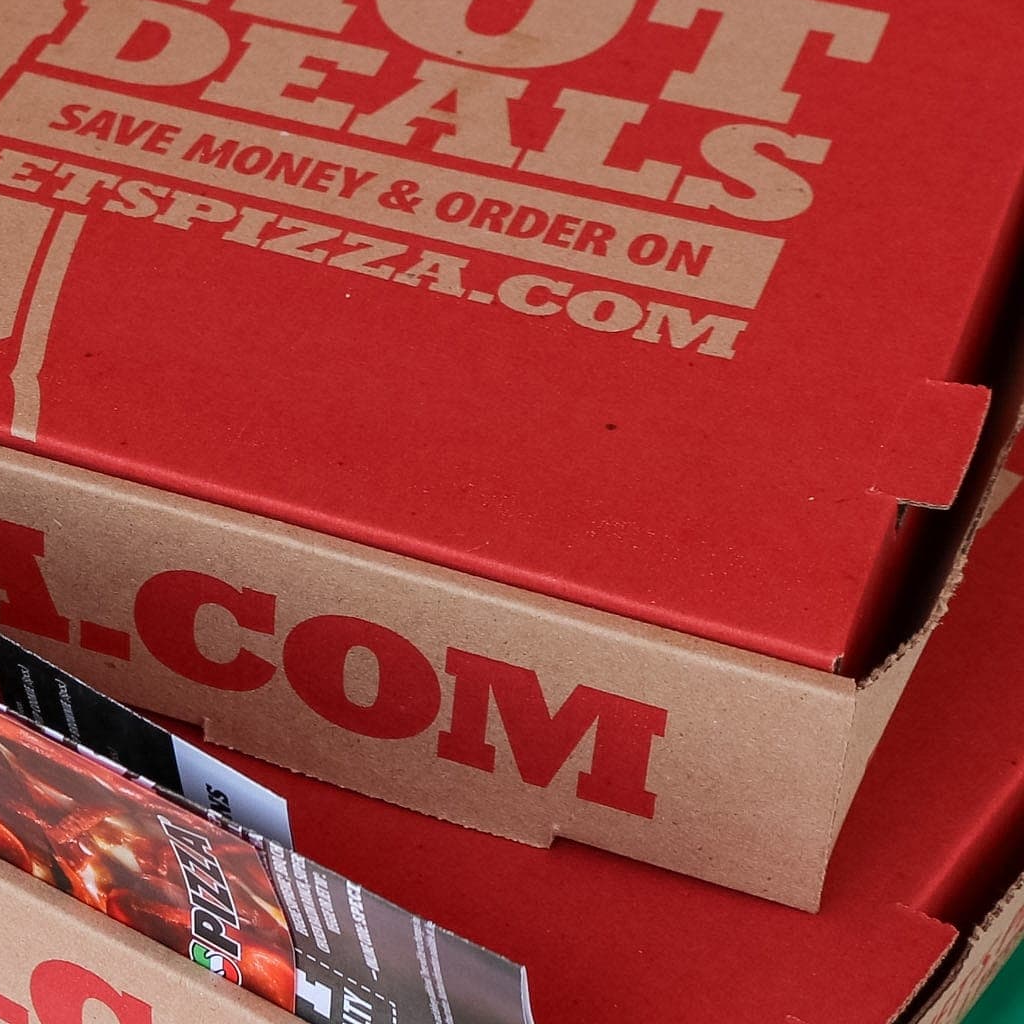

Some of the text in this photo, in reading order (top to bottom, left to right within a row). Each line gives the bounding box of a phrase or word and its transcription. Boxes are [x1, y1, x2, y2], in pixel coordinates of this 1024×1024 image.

[48, 103, 714, 277] SAVE MONEY & ORDER ON
